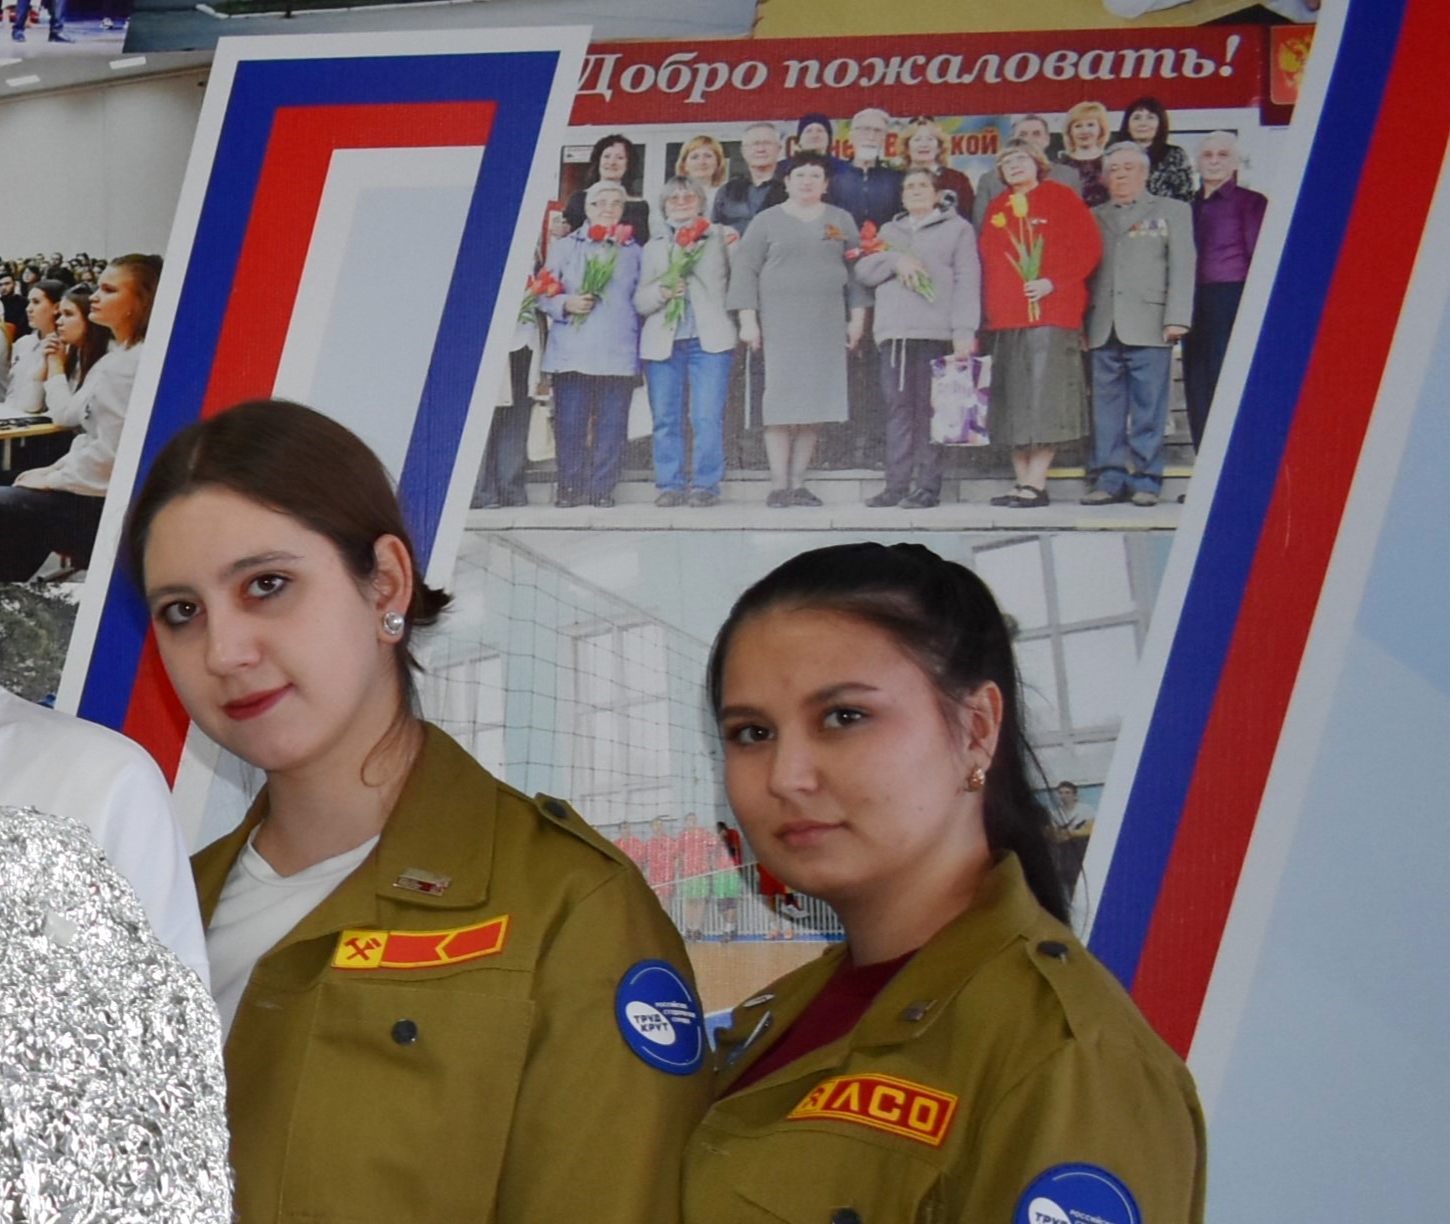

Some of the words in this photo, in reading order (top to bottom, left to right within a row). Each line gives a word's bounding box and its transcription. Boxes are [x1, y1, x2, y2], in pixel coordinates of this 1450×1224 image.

[577, 51, 768, 103] Добро
[783, 34, 1242, 89] пожаловать!
[633, 1013, 662, 1024] ТРУД
[641, 1022, 669, 1032] КРУТ
